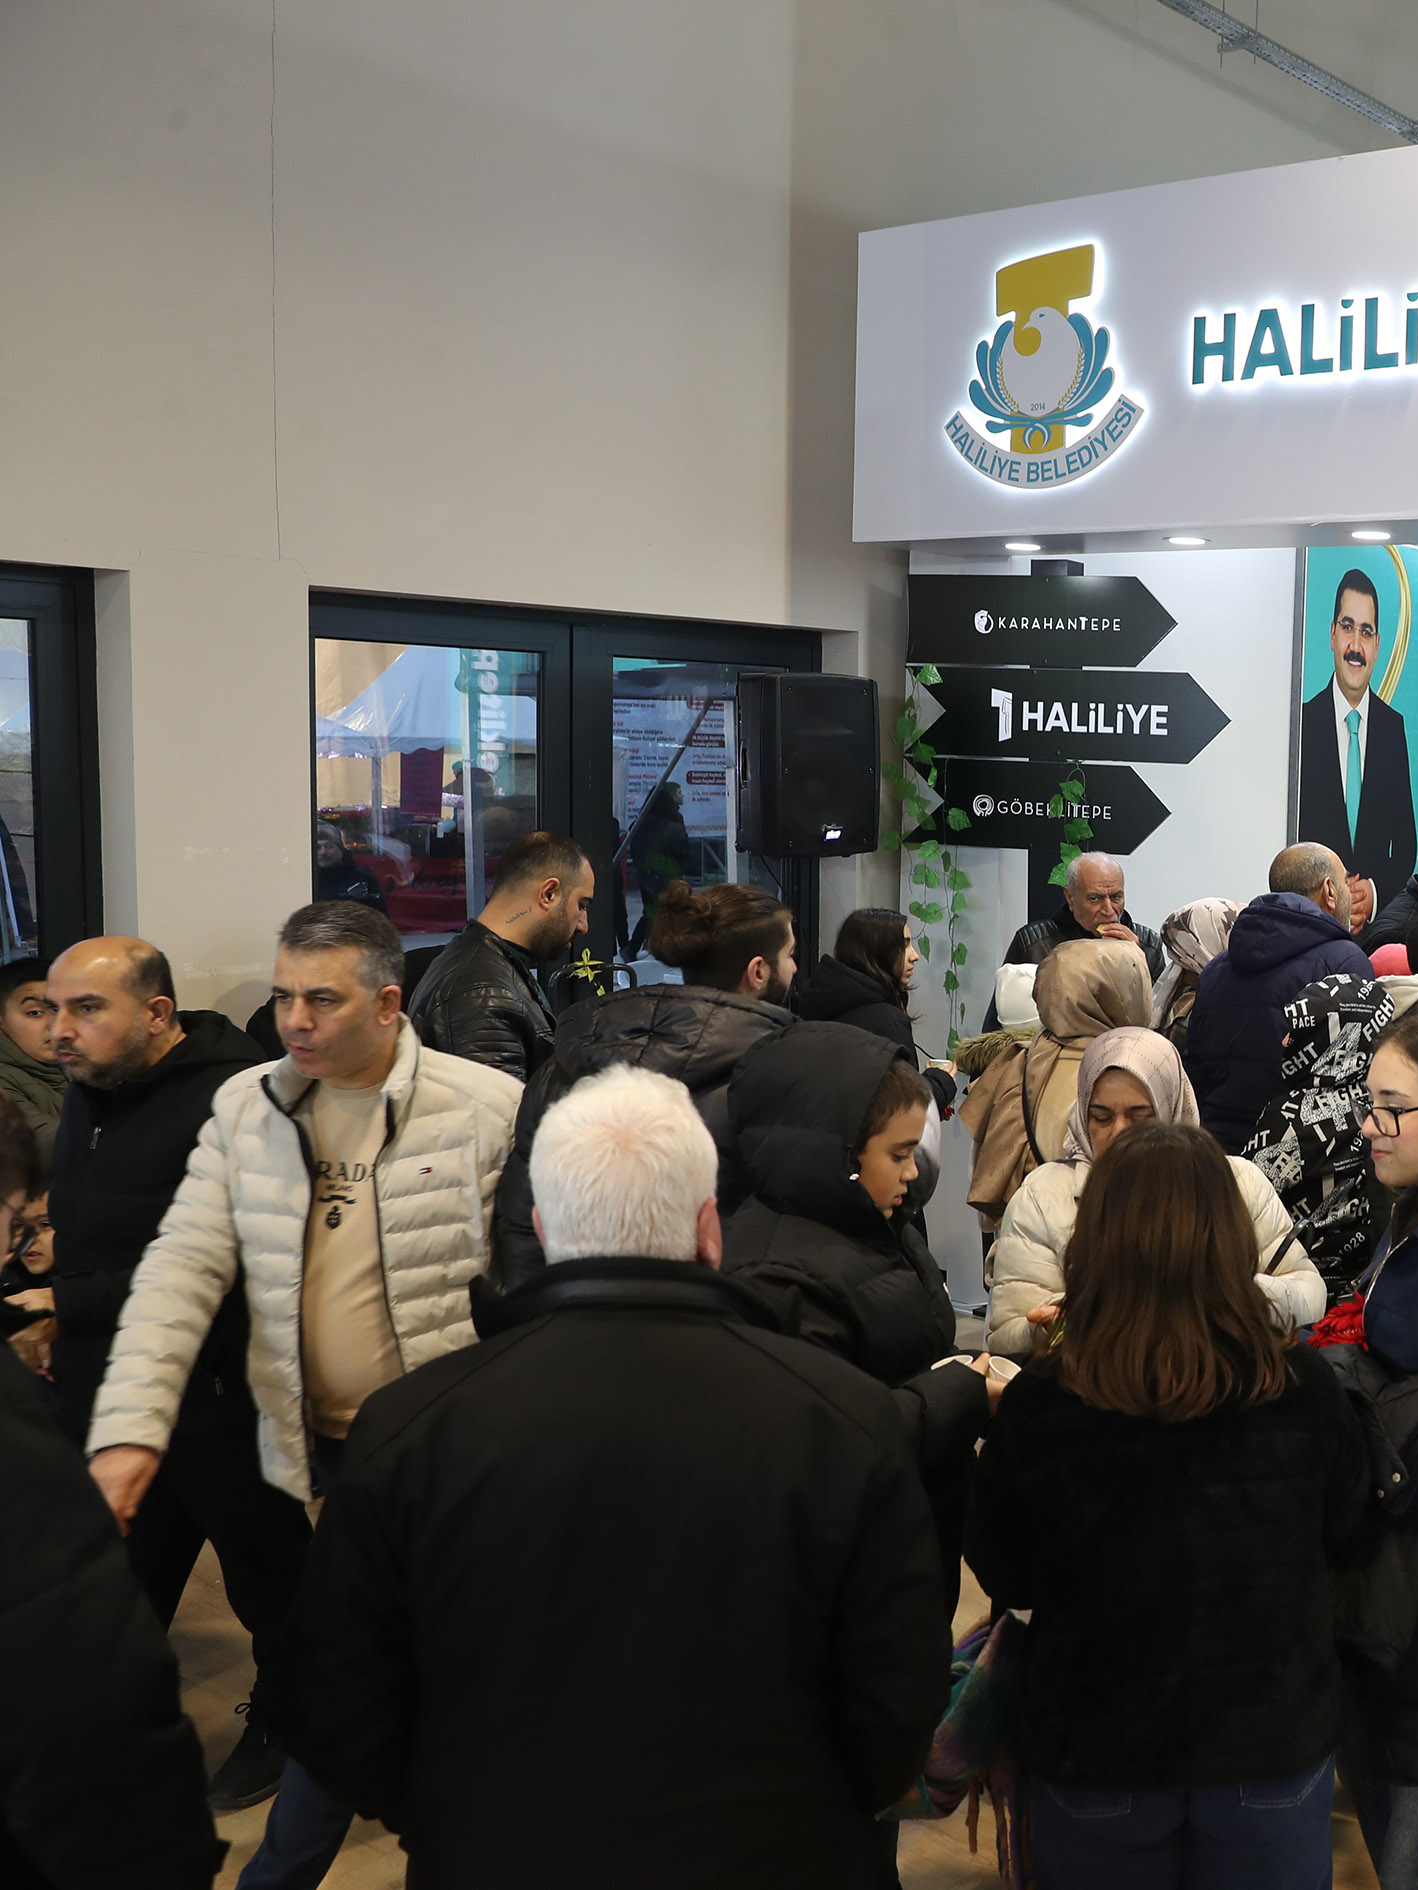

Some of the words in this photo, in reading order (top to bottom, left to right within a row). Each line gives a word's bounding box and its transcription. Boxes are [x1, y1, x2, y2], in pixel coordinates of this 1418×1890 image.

[1030, 403, 1046, 412] 2014
[946, 415, 1022, 483] HALİLİYE
[1025, 399, 1138, 483] BELEDİYESİ
[998, 616, 1121, 632] KARAHANTEPE
[996, 798, 1112, 820] GÖBEİTEPE
[1292, 1015, 1316, 1029] PACE
